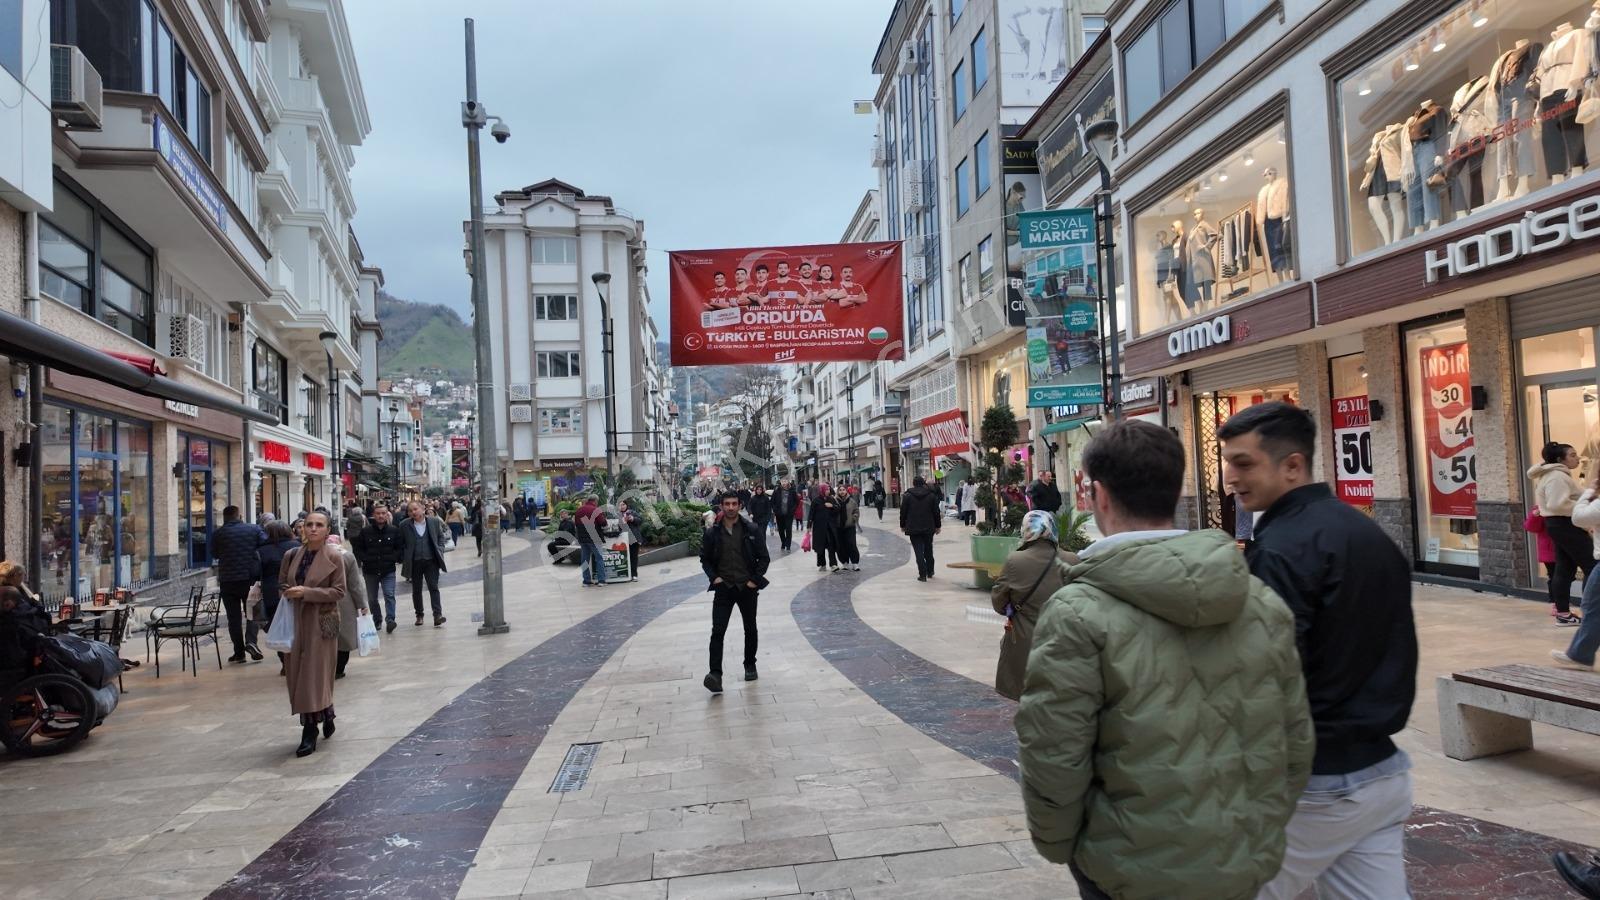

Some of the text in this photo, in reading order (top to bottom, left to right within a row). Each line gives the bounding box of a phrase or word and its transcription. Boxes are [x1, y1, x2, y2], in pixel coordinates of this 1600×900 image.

[1030, 216, 1087, 232] SOSYAL
[1028, 228, 1089, 243] MARKET
[1011, 278, 1024, 289] EP
[742, 310, 826, 324] ORDU'DA
[706, 331, 765, 342] TÜRKİYE
[774, 328, 865, 340] BULGARİSTAN
[1168, 315, 1230, 357] arma
[775, 349, 796, 358] EHF
[1121, 383, 1152, 402] dafone
